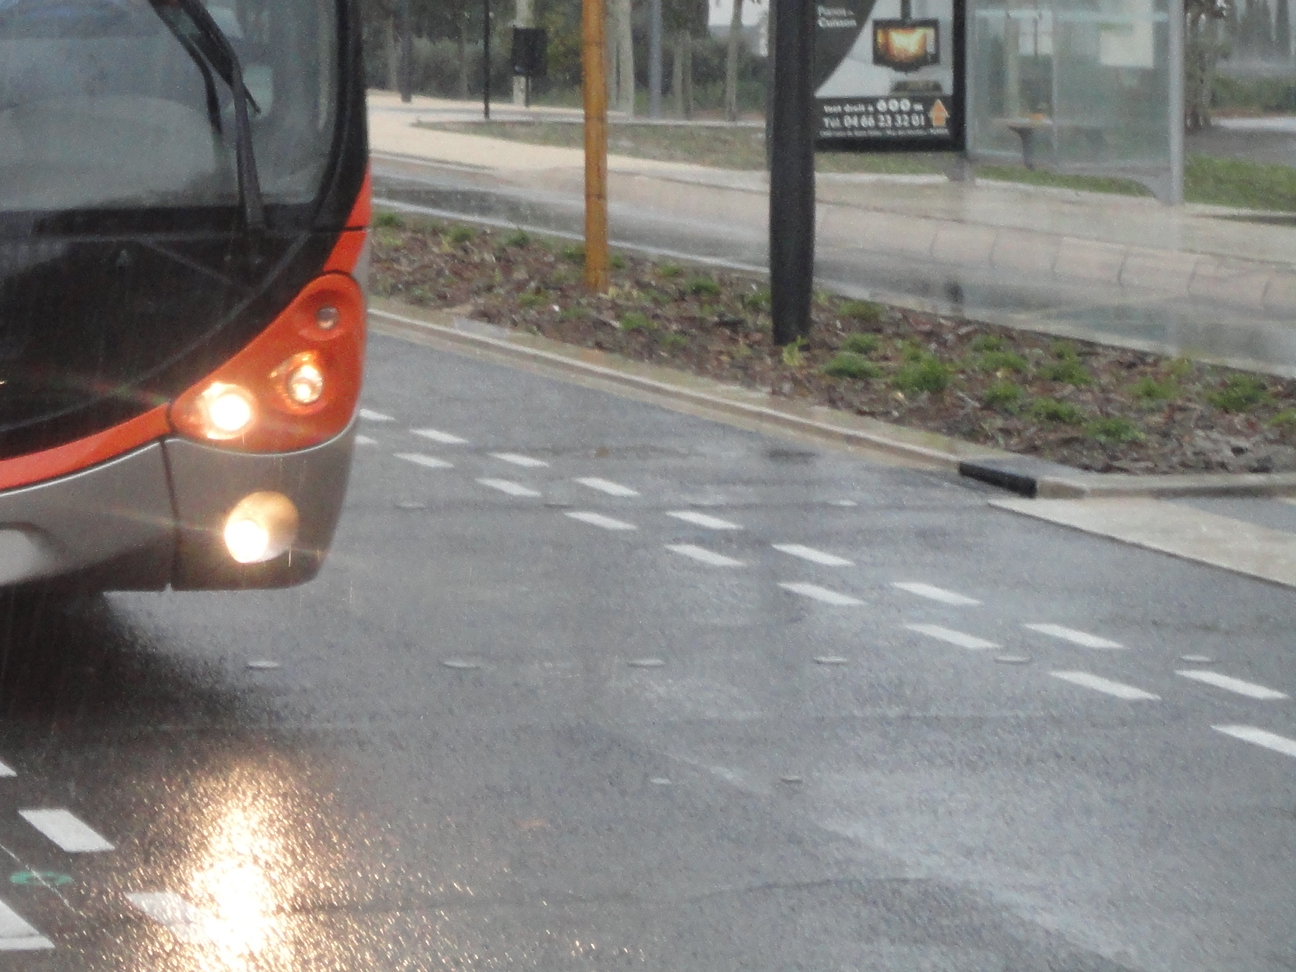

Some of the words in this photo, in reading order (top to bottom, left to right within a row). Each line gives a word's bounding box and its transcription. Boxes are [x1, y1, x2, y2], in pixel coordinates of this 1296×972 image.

[876, 98, 911, 113] 600
[844, 115, 859, 128] 04
[860, 115, 875, 128] 66
[877, 114, 892, 128] 23
[911, 113, 924, 126] 01
